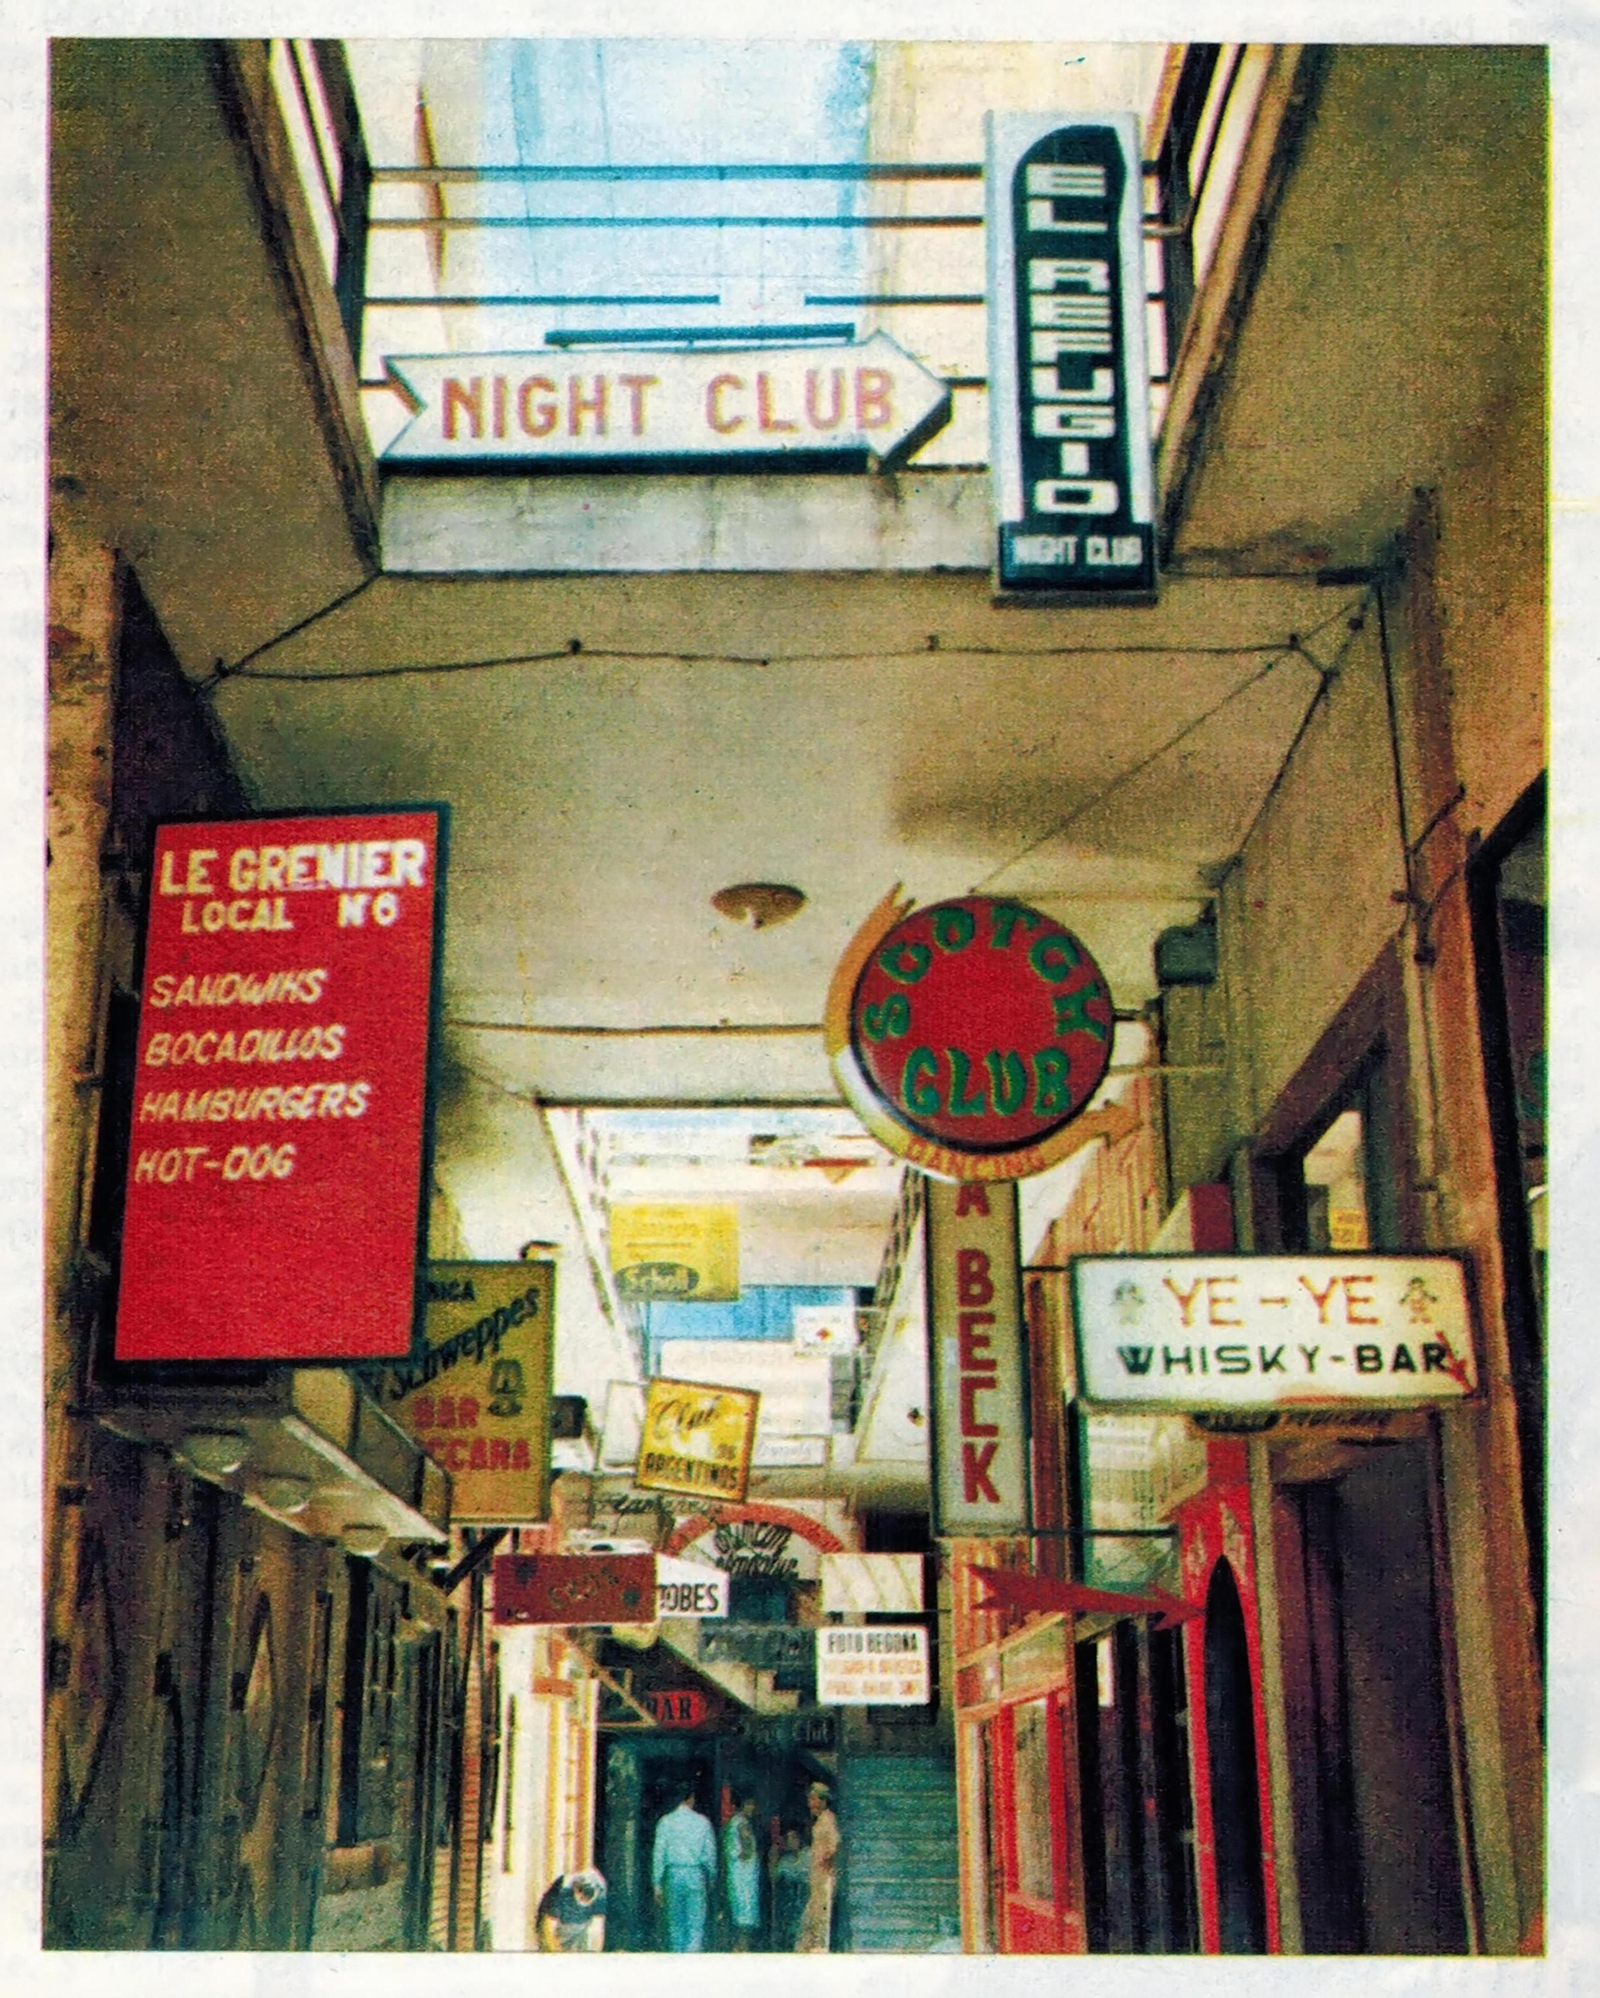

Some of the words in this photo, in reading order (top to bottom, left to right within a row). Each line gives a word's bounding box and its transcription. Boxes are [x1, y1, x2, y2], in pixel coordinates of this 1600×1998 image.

[1027, 163, 1107, 232] EL
[441, 373, 658, 440] NIGHT
[706, 366, 895, 434] CLUB
[1029, 259, 1120, 514] REFUGIO
[1014, 534, 1079, 566] NIGHT
[1085, 534, 1143, 567] CLUB
[159, 848, 219, 894] LE
[228, 838, 427, 892] GRENIER
[180, 896, 294, 934] LOCAL
[144, 1024, 345, 1066] BOCADILLOS
[139, 1082, 371, 1123] HAMBURGERS
[903, 1047, 1071, 1117] CLUB
[1117, 1343, 1448, 1375] WHISKY-BAR
[413, 1396, 479, 1429] BAR
[827, 1632, 864, 1655] FOTO
